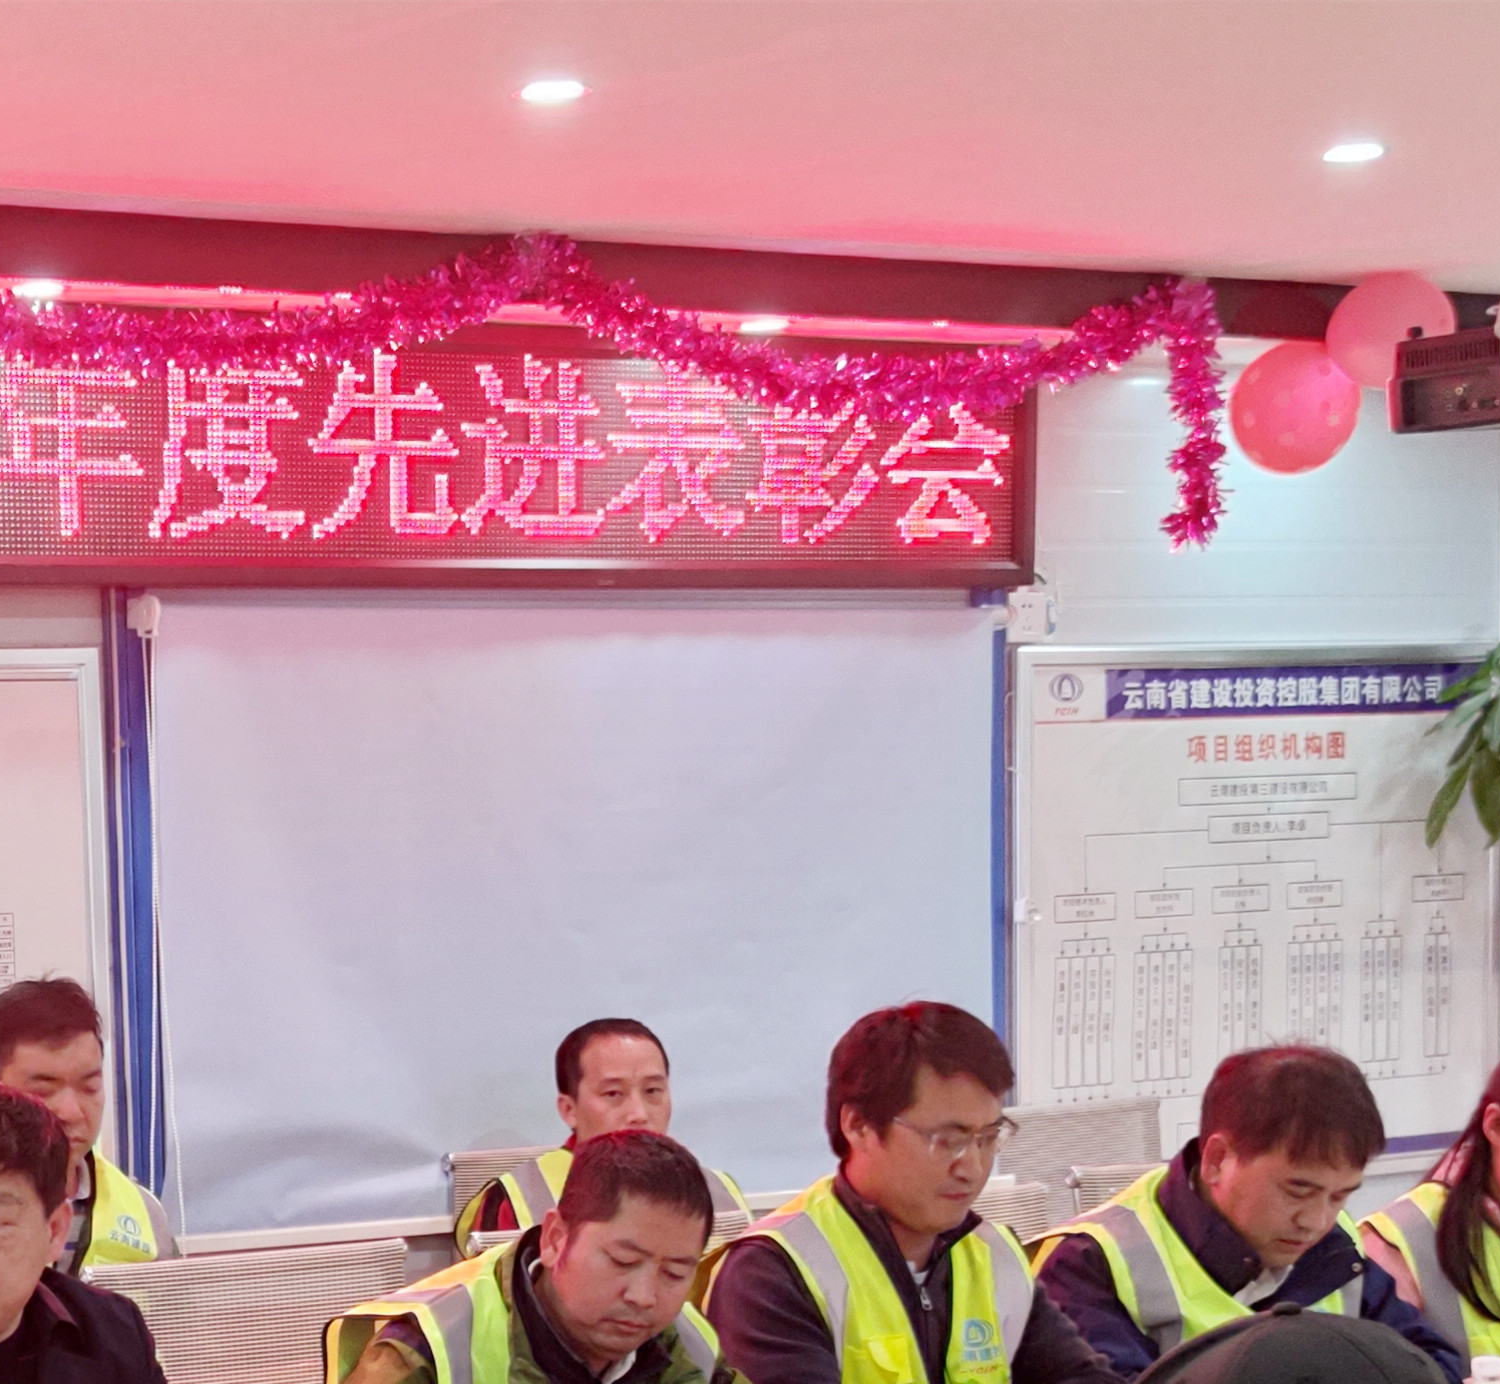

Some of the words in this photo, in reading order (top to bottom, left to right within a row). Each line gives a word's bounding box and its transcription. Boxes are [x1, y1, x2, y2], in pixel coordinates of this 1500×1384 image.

[1122, 674, 1444, 711] 云南省建设投资控股集团有限公司
[1187, 731, 1346, 763] 项目组织机构图
